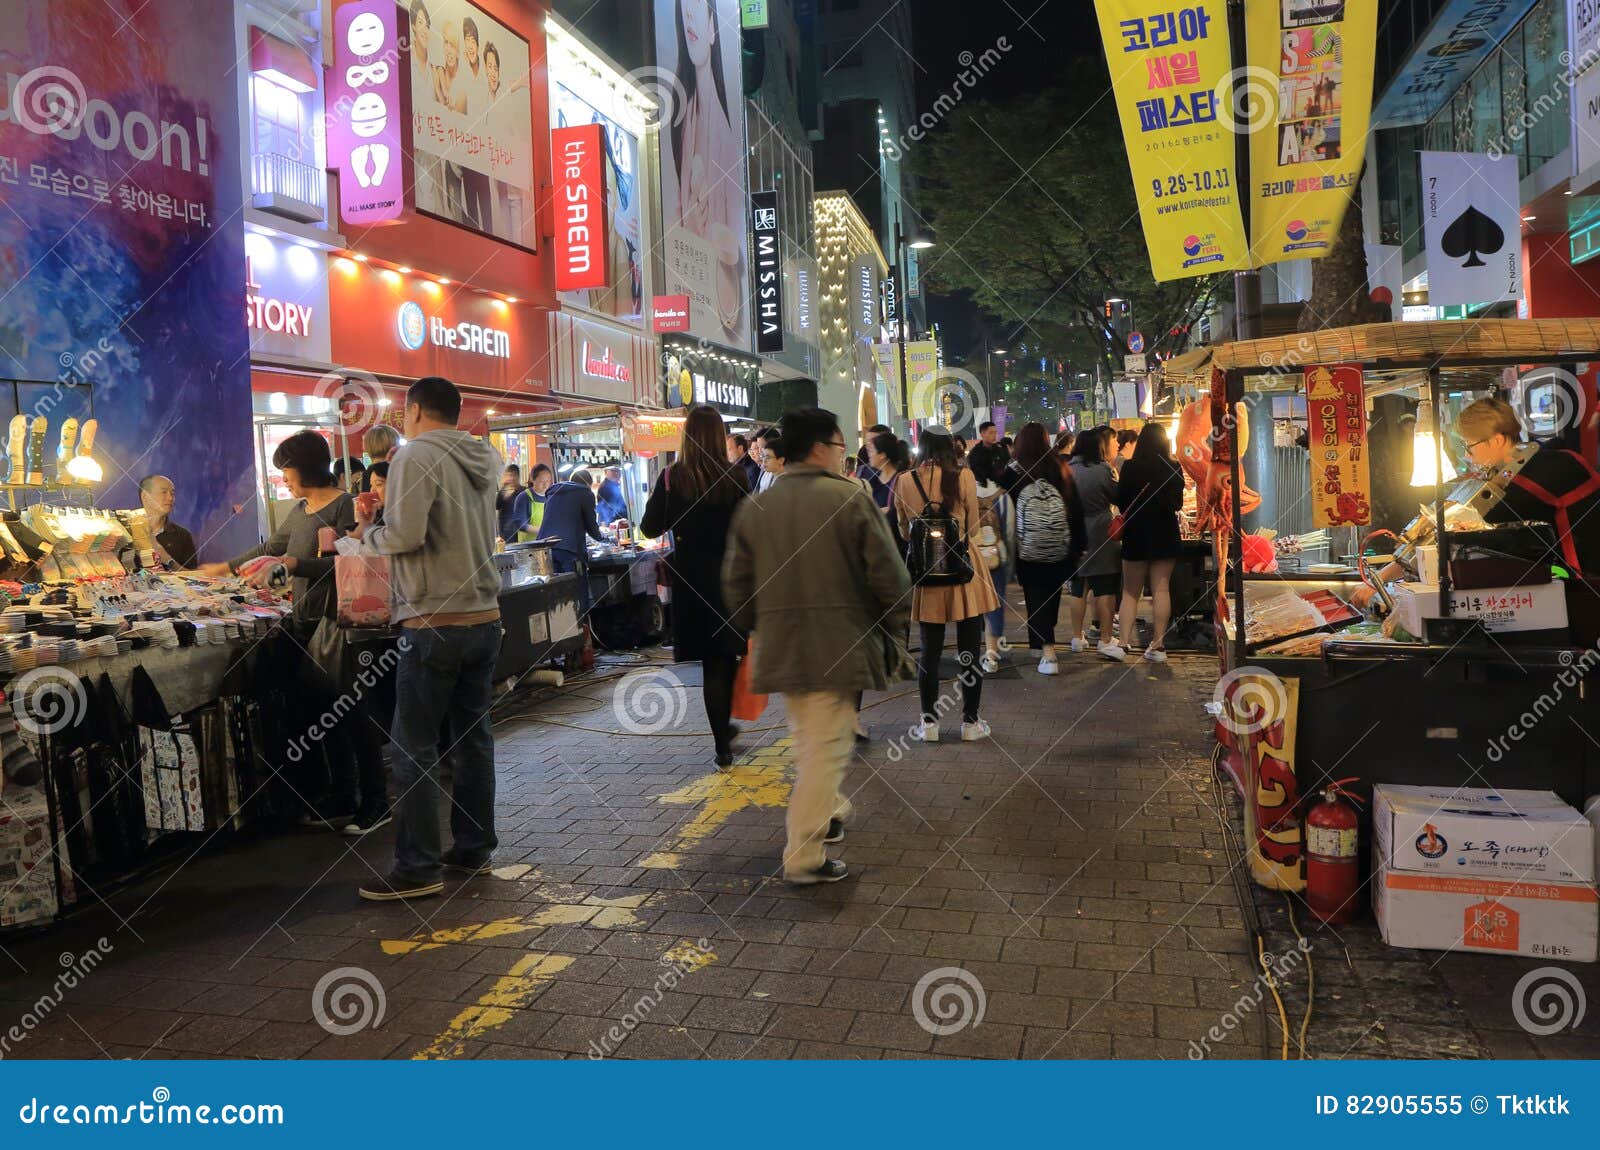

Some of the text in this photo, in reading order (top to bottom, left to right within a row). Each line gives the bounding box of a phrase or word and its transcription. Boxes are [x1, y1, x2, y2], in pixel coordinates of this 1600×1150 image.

[1120, 6, 1211, 53] 코리아
[1145, 51, 1202, 90] 세일
[46, 84, 209, 177] soon!
[1136, 89, 1220, 133] 페스타
[28, 163, 112, 204] 모습으로
[118, 183, 212, 228] 찾아옵니다.
[1429, 177, 1437, 190] 7
[360, 203, 376, 212] MASK
[377, 200, 396, 209] STORY
[246, 256, 262, 289] L
[757, 234, 778, 335] MISSHA
[1508, 280, 1516, 294] 7
[861, 265, 875, 325] innisfree
[706, 380, 750, 408] MISSHA
